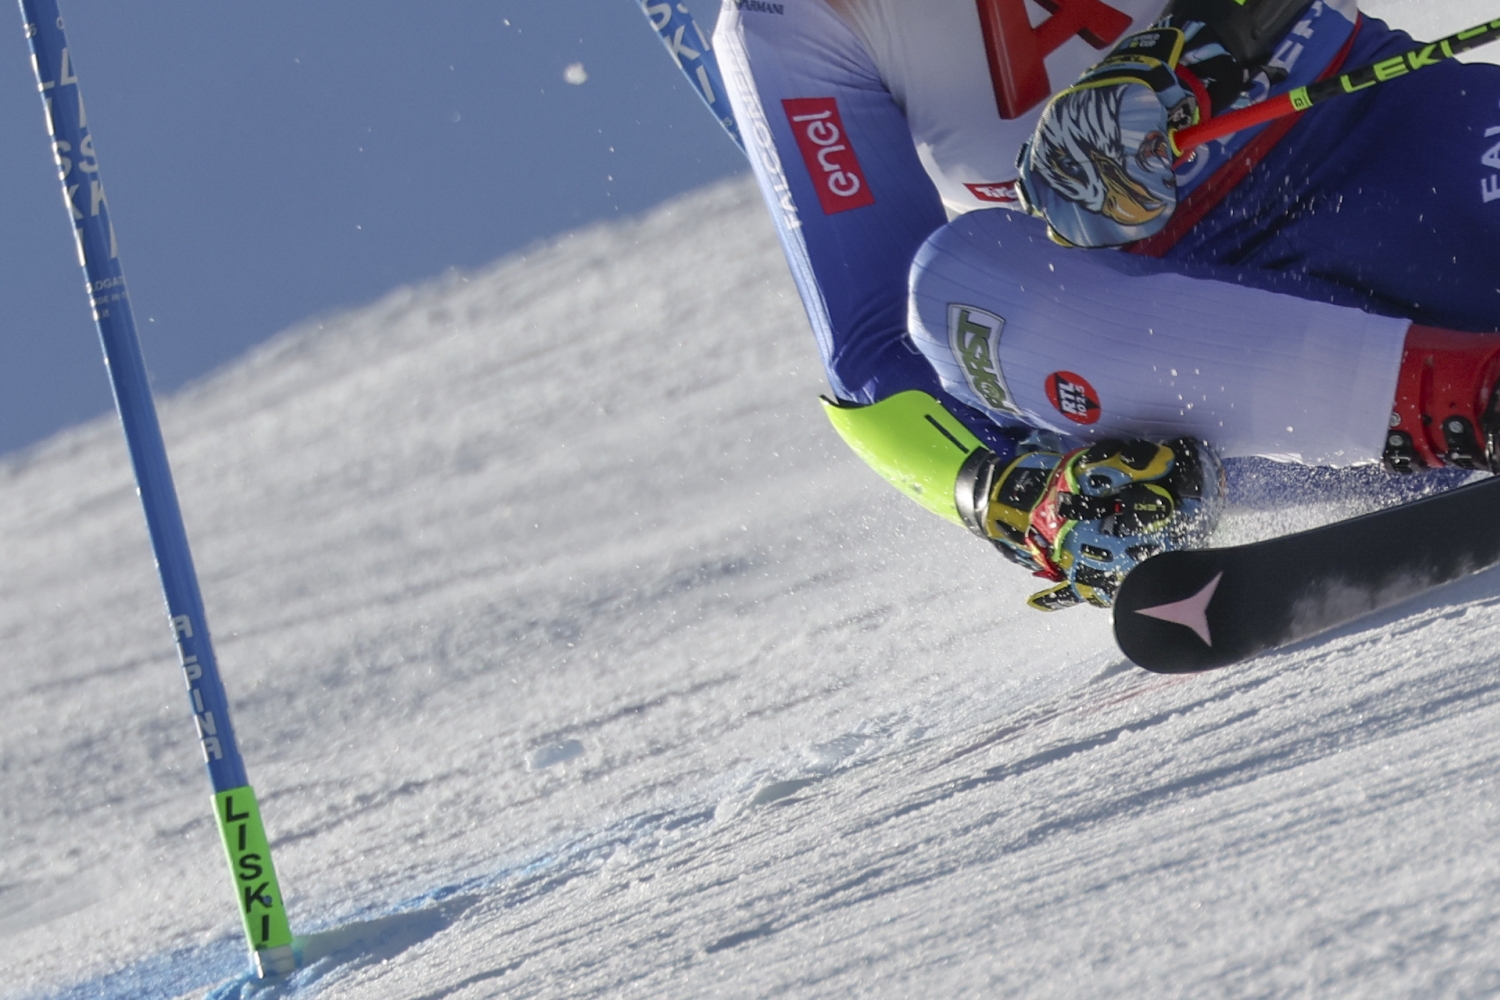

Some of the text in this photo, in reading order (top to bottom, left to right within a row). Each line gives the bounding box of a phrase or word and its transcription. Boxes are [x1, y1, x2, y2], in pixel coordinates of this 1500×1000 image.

[1340, 40, 1453, 93] LEKI
[793, 110, 861, 198] enel
[1058, 382, 1078, 416] RTL
[1075, 384, 1088, 418] 102.5
[170, 614, 222, 763] ALPINA
[226, 796, 273, 942] LISKI
